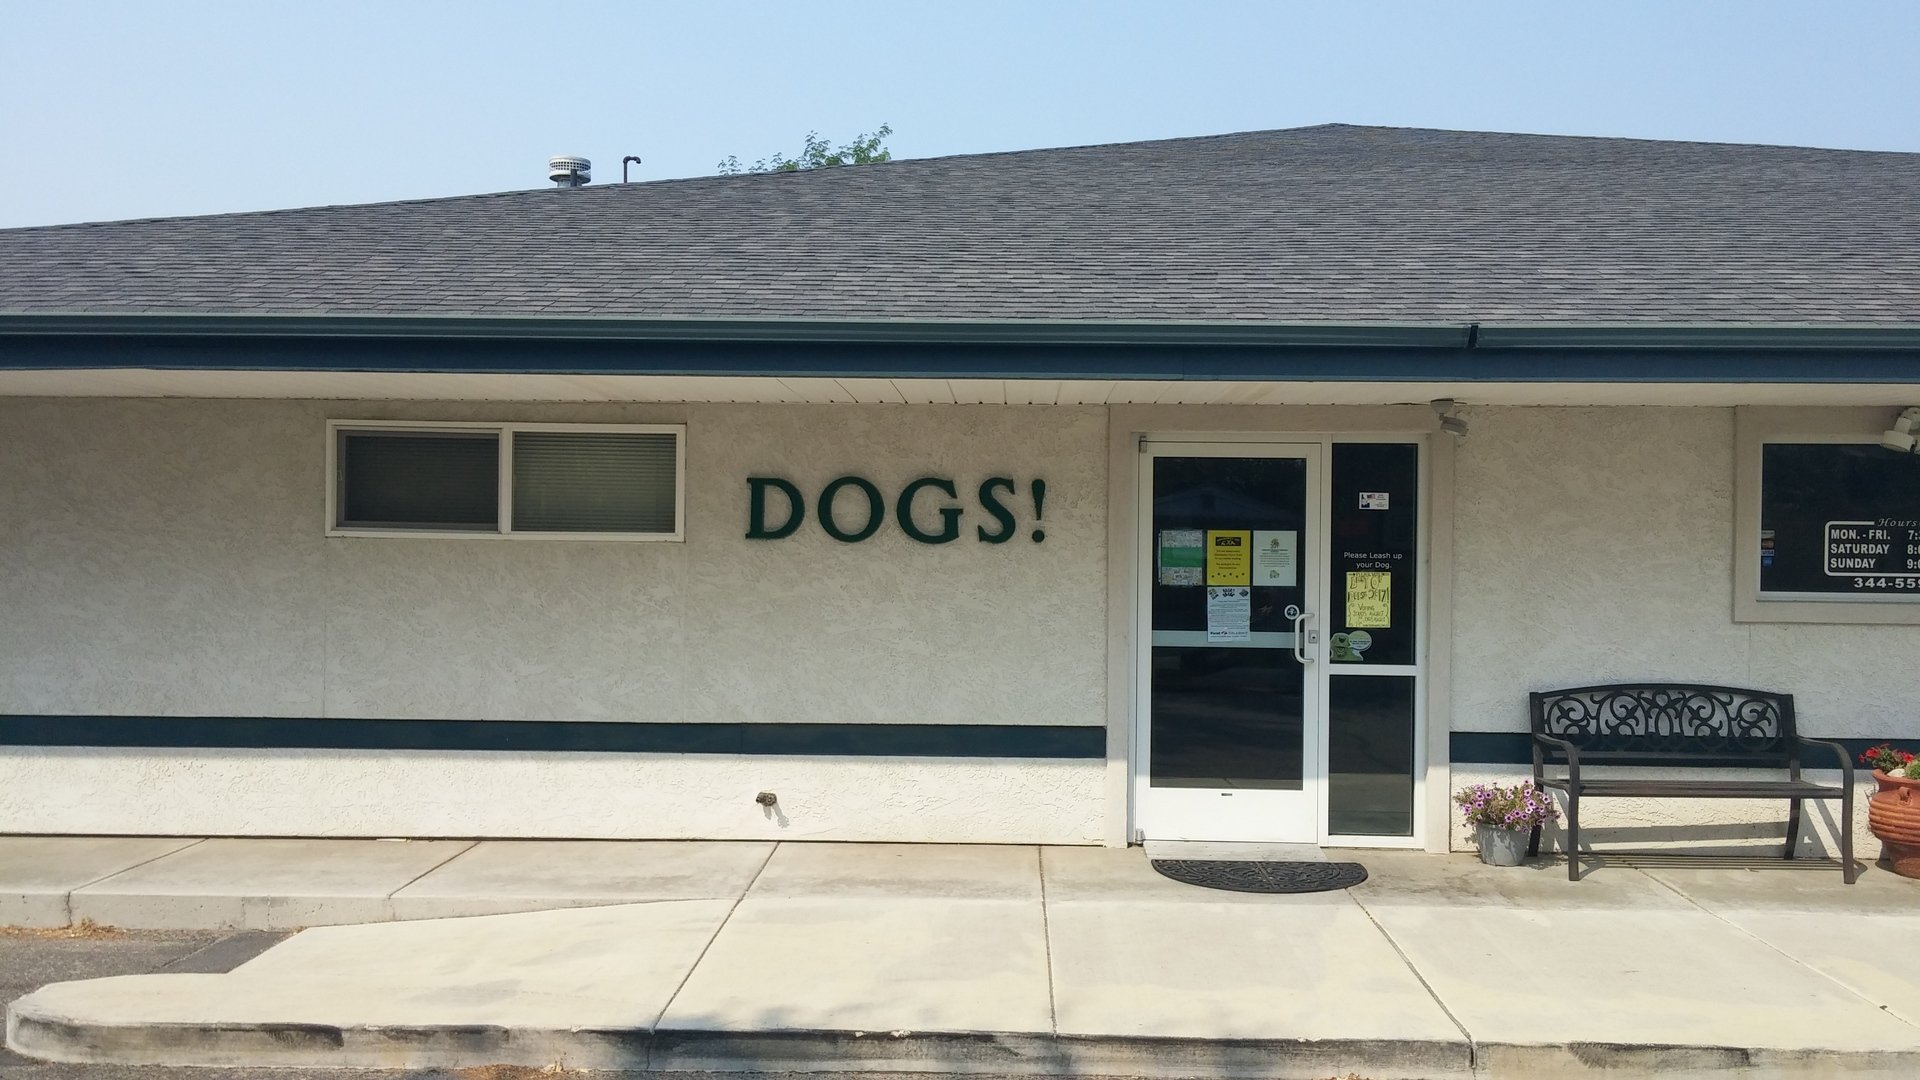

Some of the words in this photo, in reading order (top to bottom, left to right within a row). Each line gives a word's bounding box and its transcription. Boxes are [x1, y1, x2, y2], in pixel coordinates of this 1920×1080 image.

[745, 476, 1046, 544] DOGS!
[1877, 517, 1918, 527] Hours
[1830, 543, 1890, 554] SATURDAY
[1830, 558, 1876, 569] SUNDAY
[1854, 578, 1920, 589] 344-55
